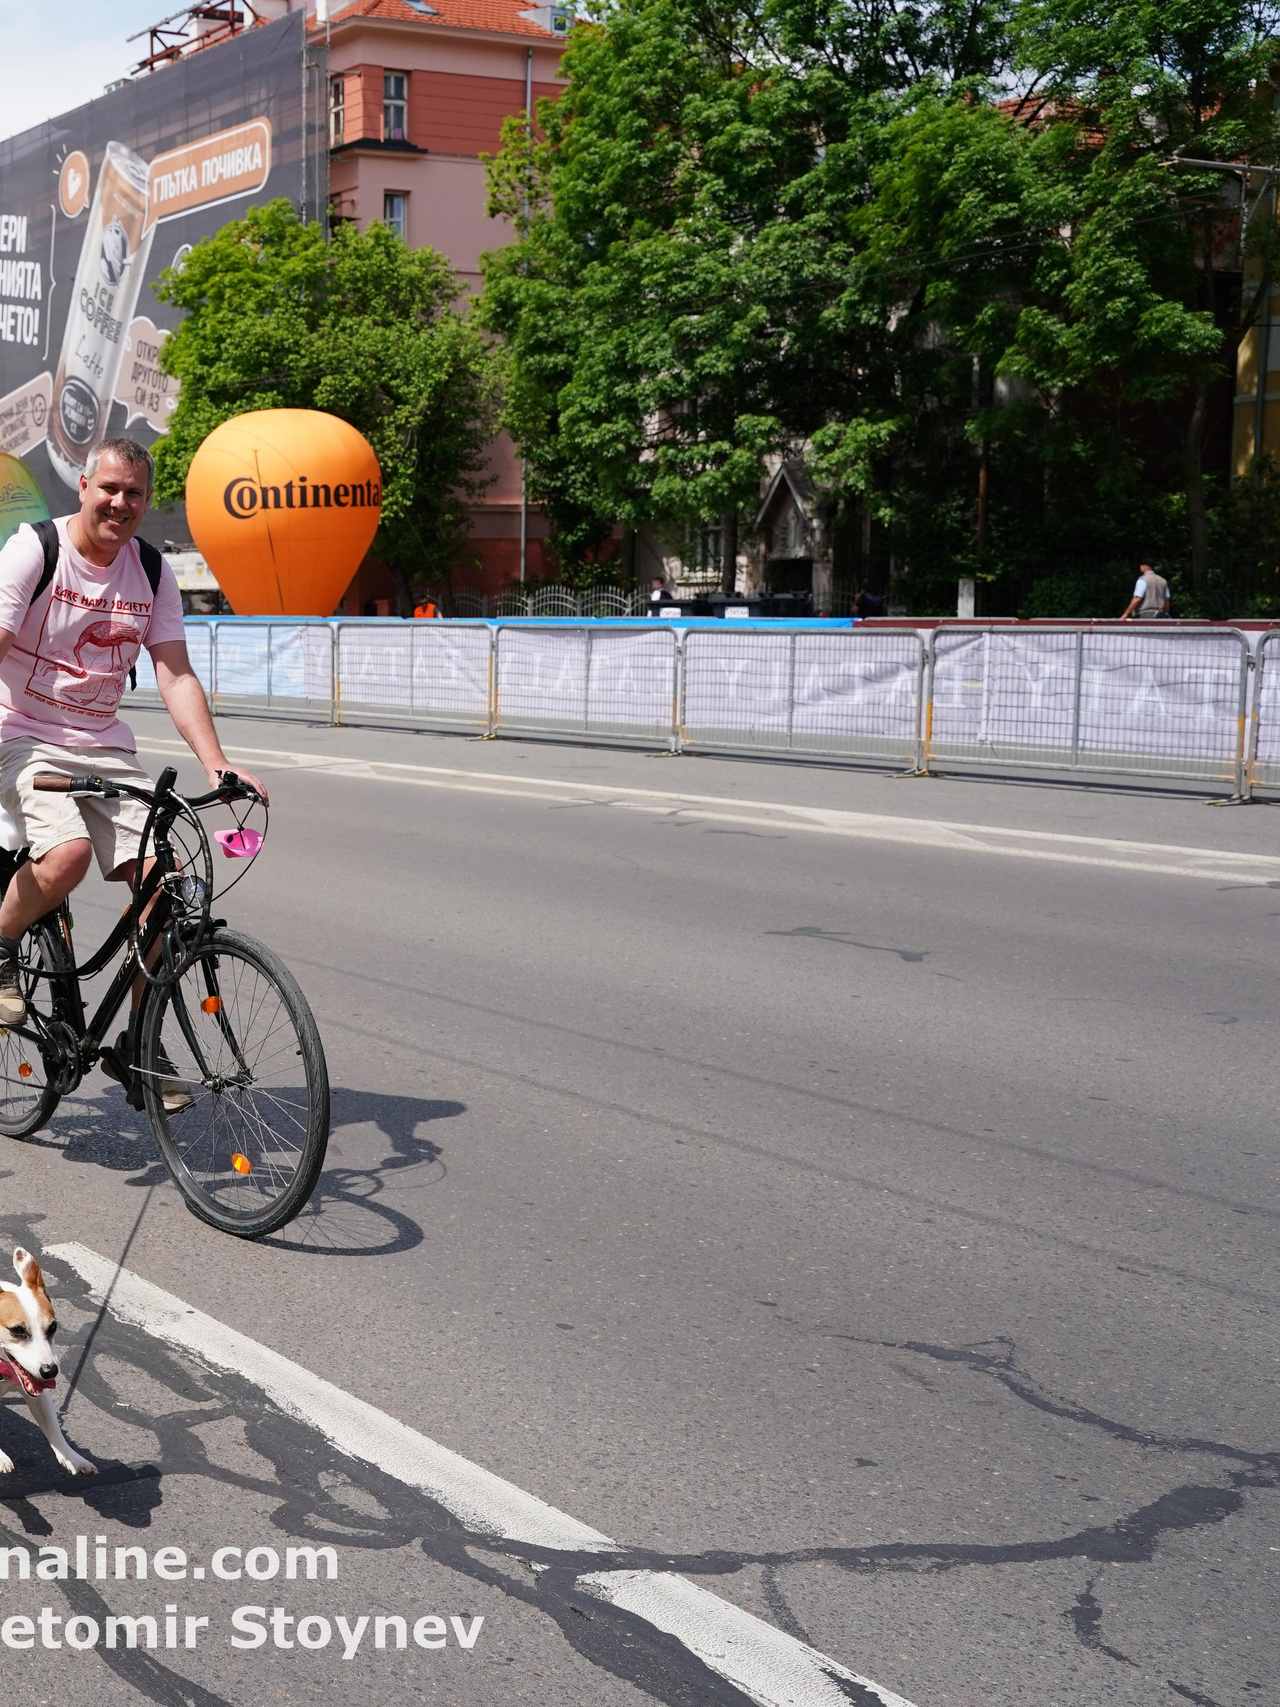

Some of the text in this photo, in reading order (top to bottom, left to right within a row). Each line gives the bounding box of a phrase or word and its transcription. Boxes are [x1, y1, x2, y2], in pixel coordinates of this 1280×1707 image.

[153, 142, 263, 204] ГЛЪТКА ПОЧИВКА
[80, 288, 123, 344] COFFEE
[75, 334, 104, 379] Latte
[136, 340, 163, 367] ОТКР
[132, 361, 169, 393] ДРУГОТО
[135, 386, 160, 413] СИ АЗ
[224, 476, 382, 519] Continental
[111, 600, 151, 613] SOCIETY
